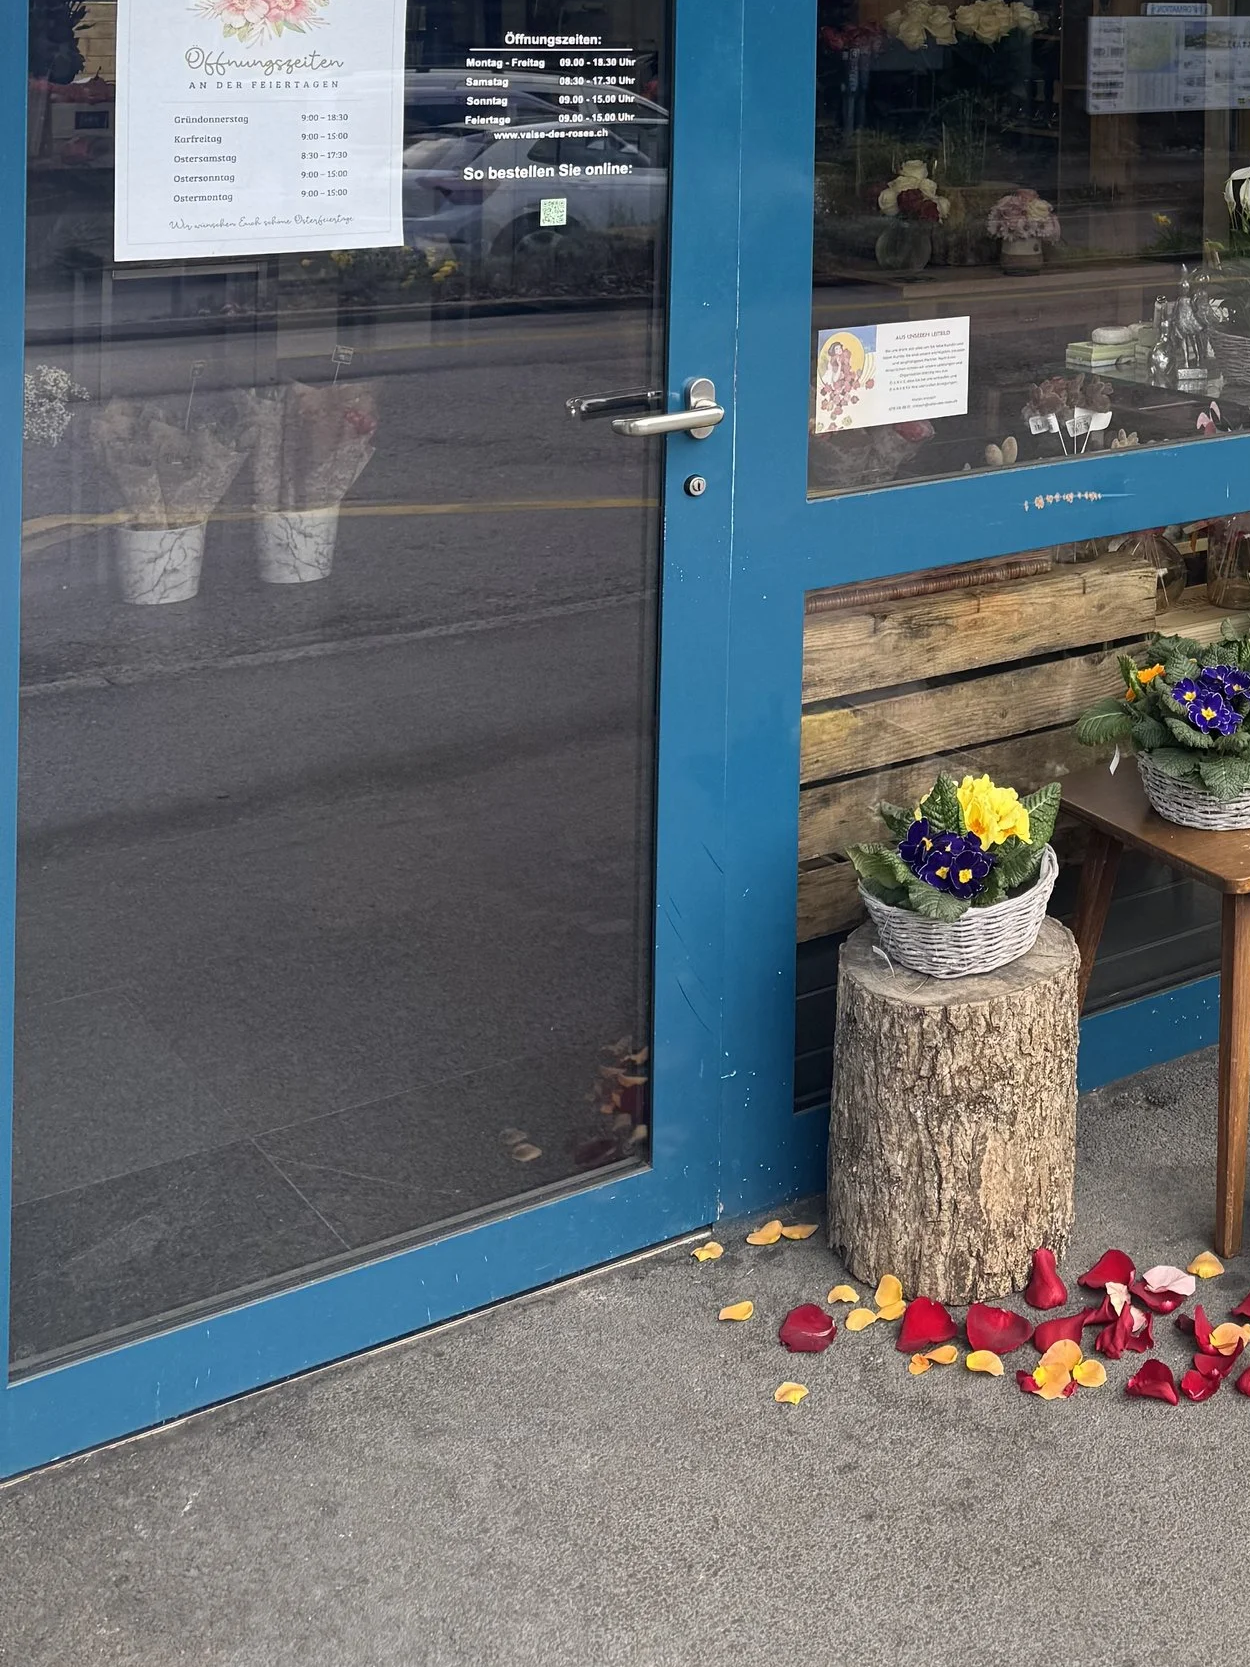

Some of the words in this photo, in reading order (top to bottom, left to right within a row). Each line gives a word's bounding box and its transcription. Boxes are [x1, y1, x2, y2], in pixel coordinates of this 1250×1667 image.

[504, 31, 602, 47] Öffnungszeiten:
[185, 44, 344, 76] Öffnungszeiten
[466, 57, 503, 69] Montag
[511, 57, 546, 69] Freitag
[559, 57, 584, 67] 09.00
[592, 57, 617, 67] 18.30
[619, 57, 636, 67] Uhr
[188, 80, 207, 90] AN
[216, 80, 243, 90] DER
[251, 80, 340, 89] FEIERTAGEN
[466, 77, 509, 88] Samstag
[592, 76, 617, 85] 17.30
[618, 76, 636, 85] Uhr
[466, 96, 508, 107] Sonntag
[558, 95, 584, 104] 09.00
[592, 94, 616, 104] 15.00
[618, 94, 636, 103] Uhr
[174, 115, 249, 125] Gründonnerstag
[301, 113, 319, 122] 9:00
[327, 113, 349, 122] 18:30
[465, 115, 512, 126] Feiertage
[558, 114, 584, 123] 09.00
[592, 113, 616, 122] 15.00
[618, 112, 635, 122] Uhr
[174, 134, 222, 145] Karfreitag
[301, 132, 319, 141] 9:00
[327, 132, 349, 140] 15:00
[173, 154, 237, 164] Ostersamstag
[301, 151, 319, 160] 8:30
[327, 151, 348, 159] 17:30
[301, 170, 319, 178] 9:00
[327, 170, 348, 178] 15:00
[463, 166, 484, 181] So
[488, 164, 555, 180] bestellen
[558, 163, 581, 177] Sie
[584, 162, 633, 176] online:
[173, 173, 235, 183] Ostersonntag
[173, 193, 233, 203] Ostermontag
[301, 189, 319, 198] 9:00
[327, 189, 348, 197] 15:00
